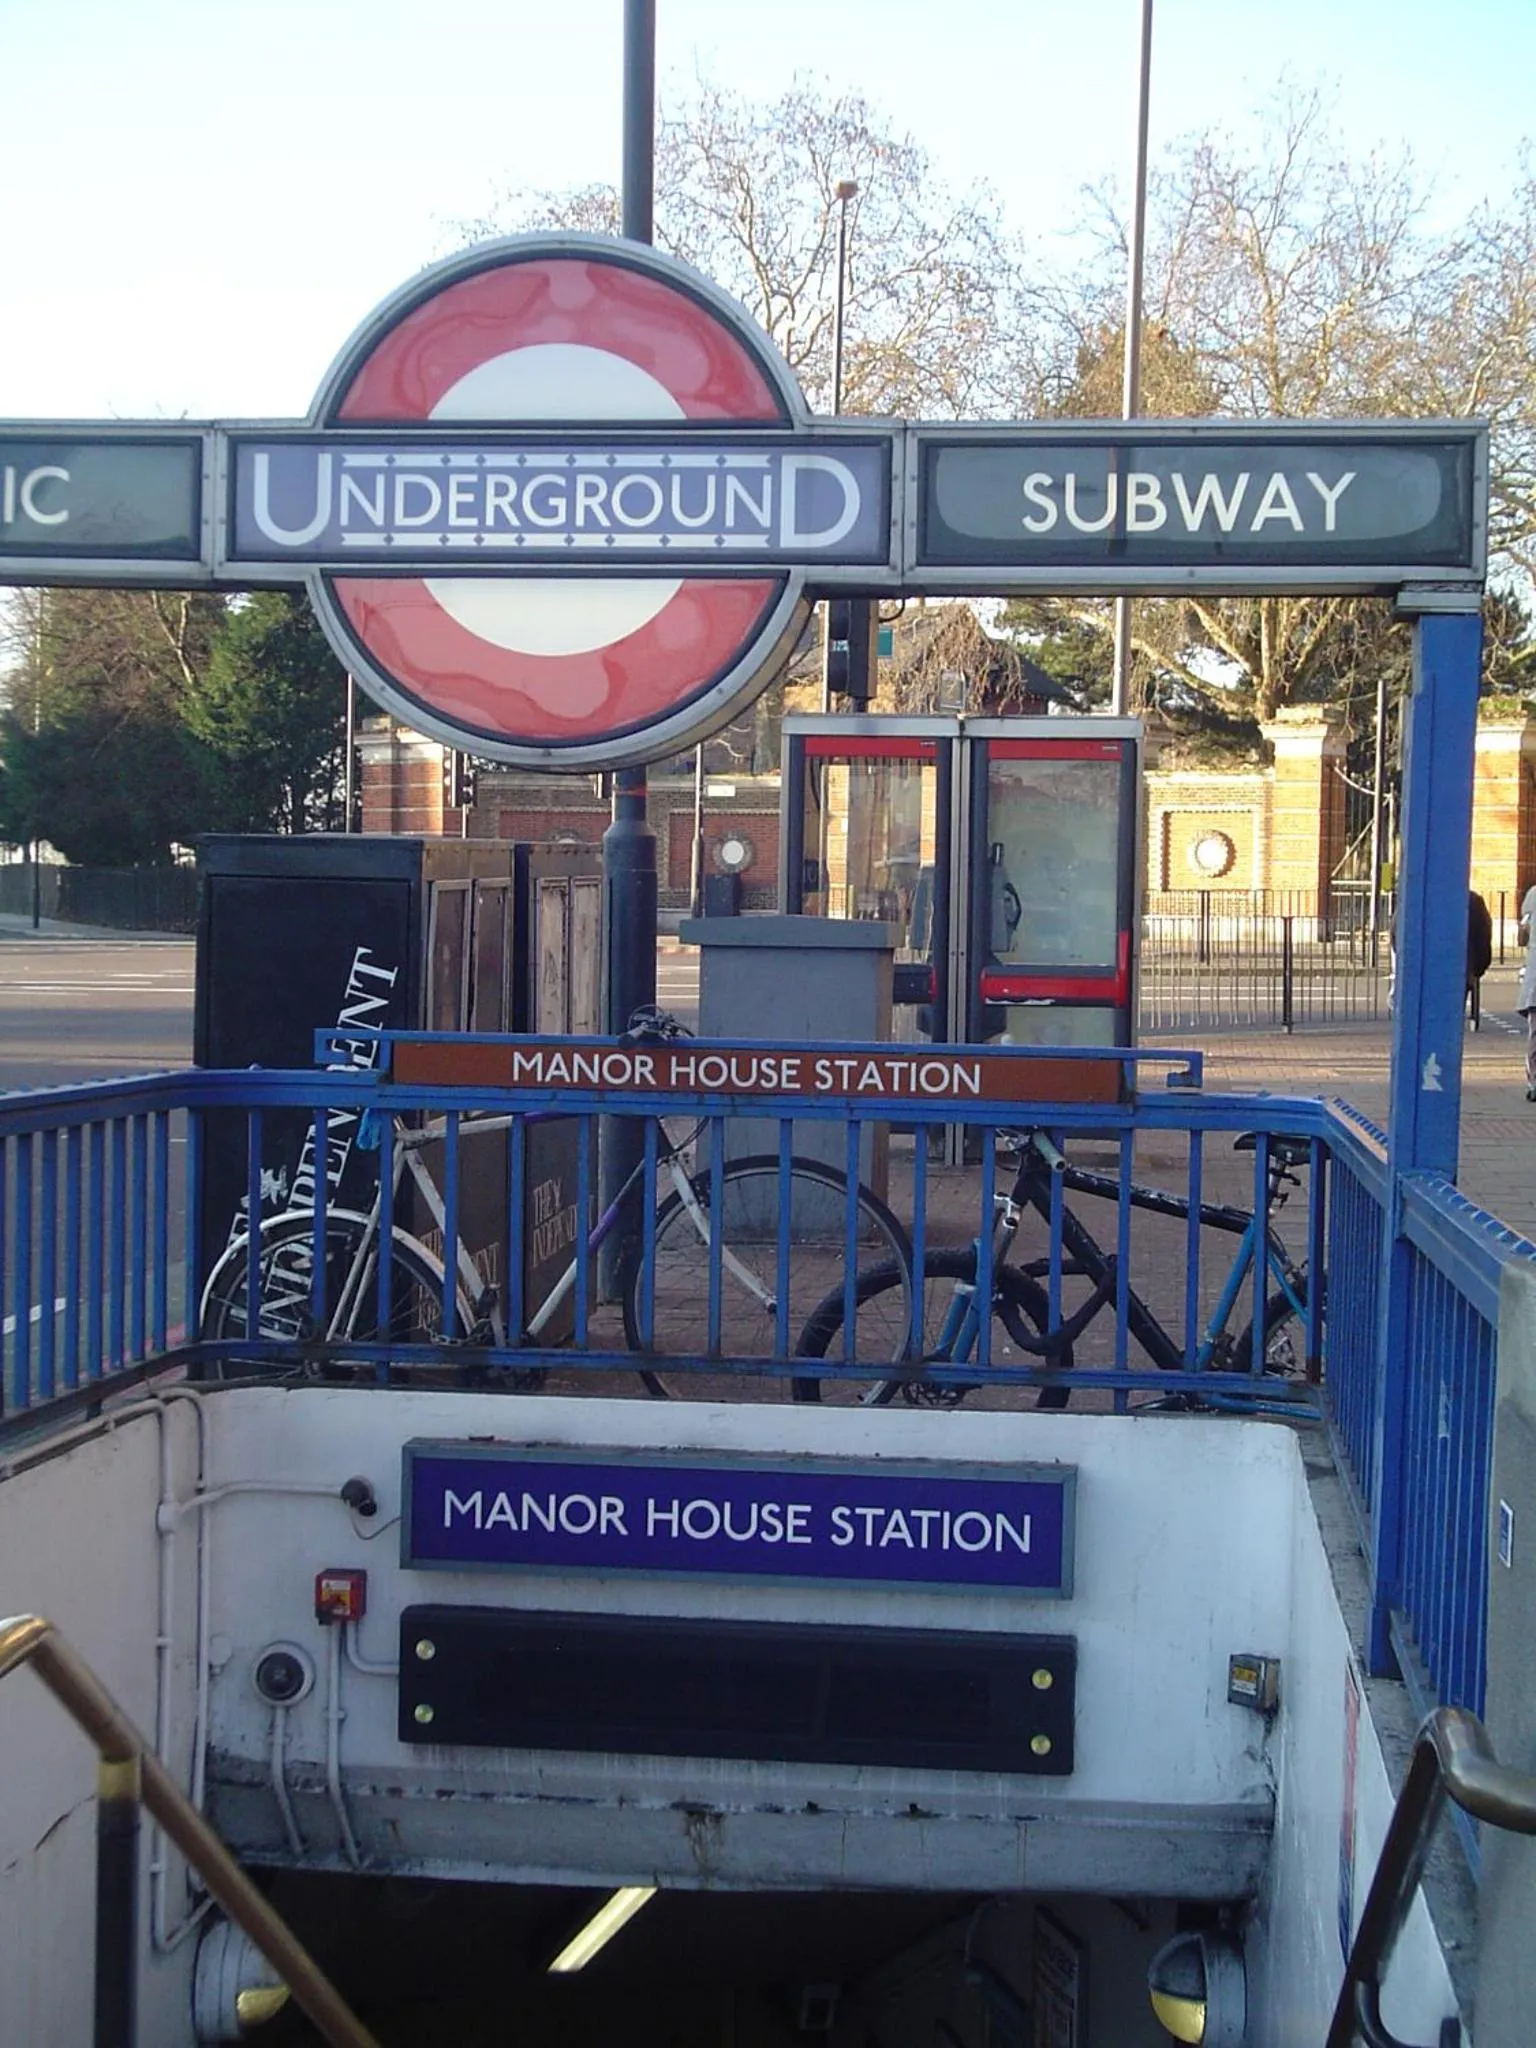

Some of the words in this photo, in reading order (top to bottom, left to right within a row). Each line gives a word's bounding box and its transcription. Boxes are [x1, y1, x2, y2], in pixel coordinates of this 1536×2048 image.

[4, 466, 70, 524] IC
[254, 453, 860, 548] UNDERGROUND
[1022, 472, 1357, 533] SUBWAY
[512, 1052, 657, 1085] MANOR
[670, 1056, 800, 1089] HOUSE
[814, 1059, 981, 1095] STATION
[255, 946, 398, 1342] INDPENENT
[443, 1489, 629, 1536] MANOR
[646, 1497, 812, 1544] HOUSE
[830, 1505, 1031, 1554] STATION
